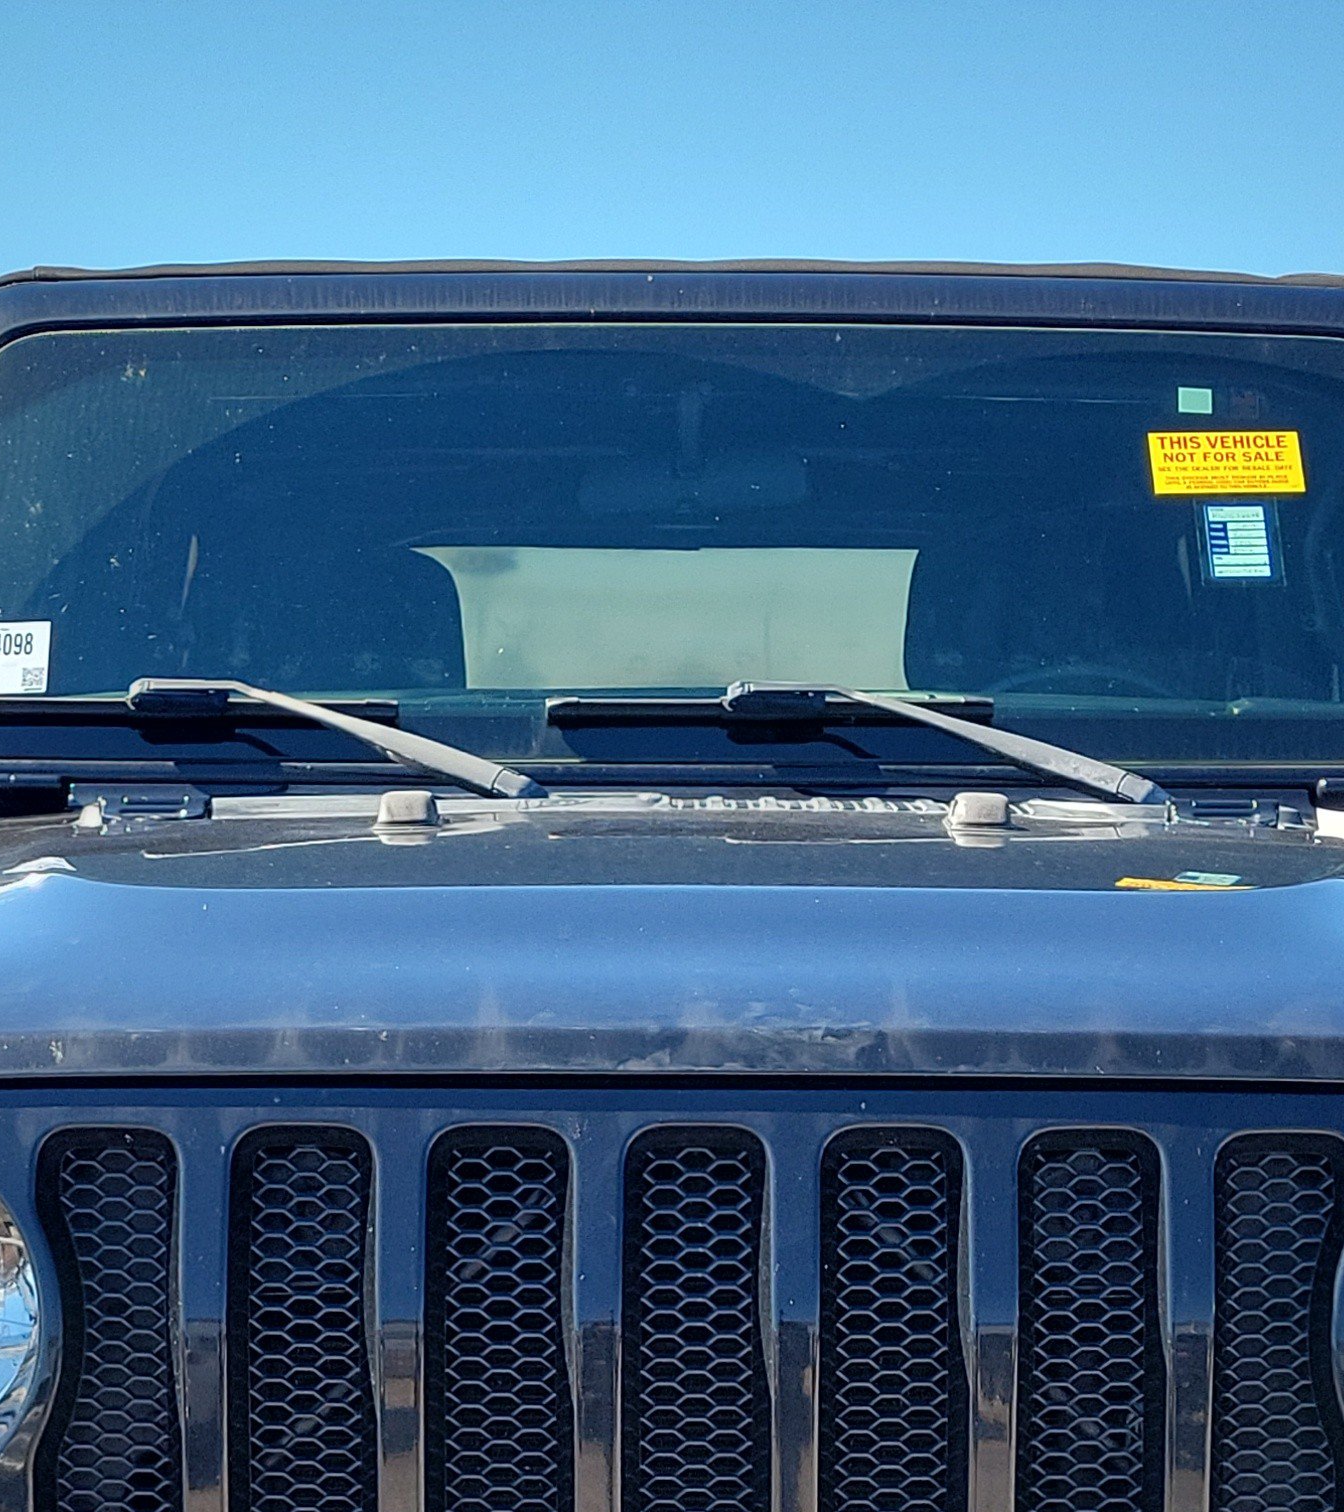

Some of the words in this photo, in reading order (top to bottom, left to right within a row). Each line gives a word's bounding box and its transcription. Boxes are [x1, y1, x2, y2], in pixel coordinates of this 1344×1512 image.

[1156, 436, 1202, 450] THIS
[1205, 435, 1288, 449] VEHICLE
[1163, 452, 1196, 463] NOT
[1203, 452, 1236, 462] FOR
[1242, 451, 1285, 462] SALE
